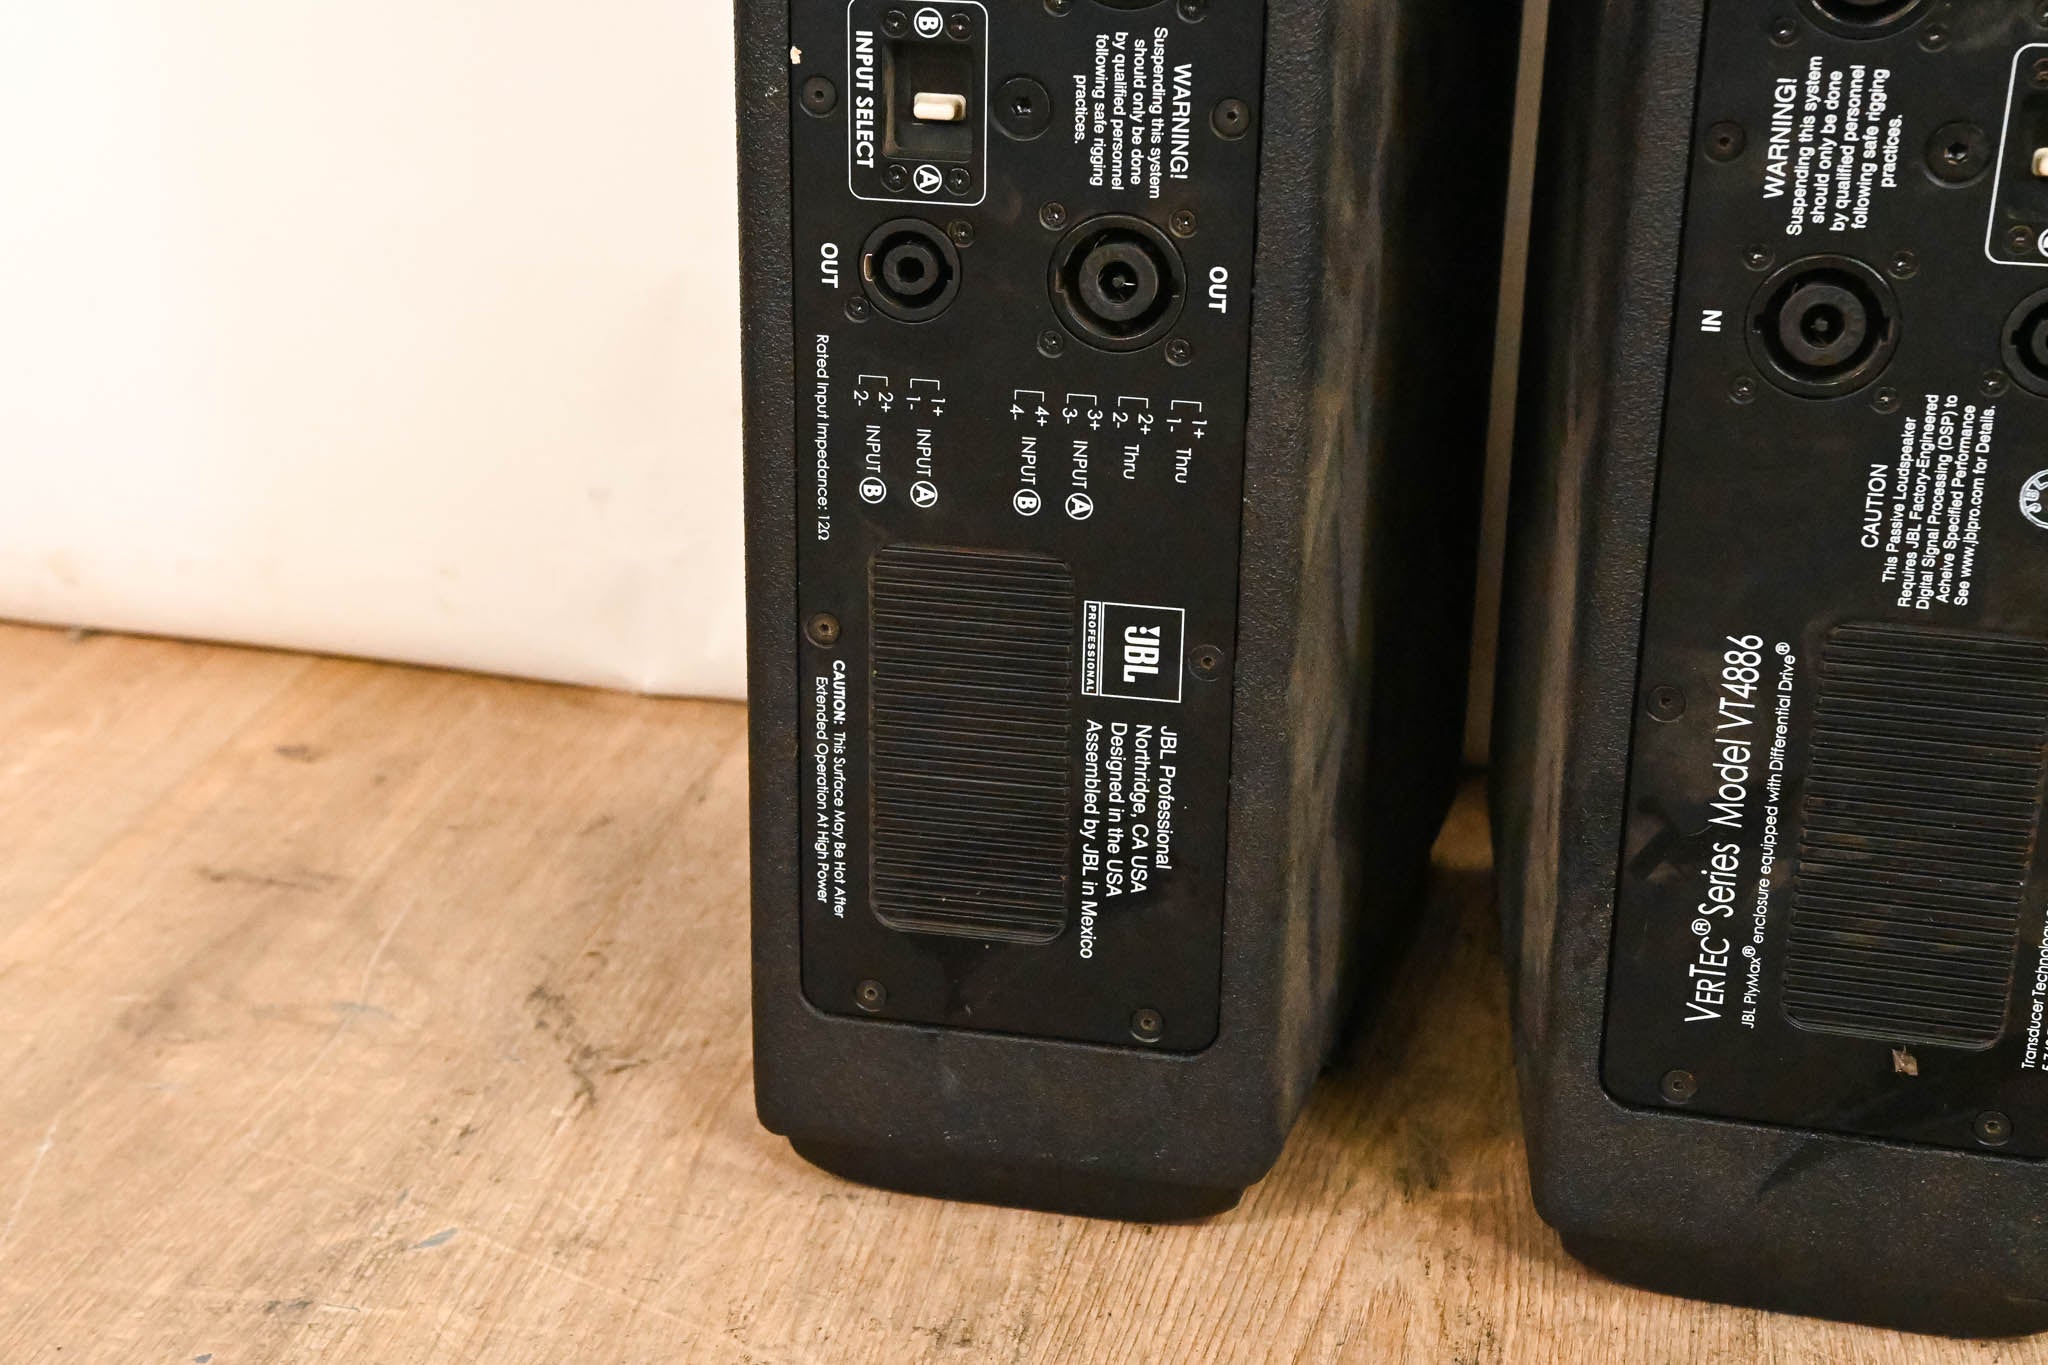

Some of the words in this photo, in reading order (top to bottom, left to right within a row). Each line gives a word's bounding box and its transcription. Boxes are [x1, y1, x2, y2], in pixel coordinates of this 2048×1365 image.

[856, 31, 873, 91] INPUT
[1112, 32, 1128, 50] by
[1133, 39, 1147, 88] should
[1092, 34, 1109, 98] following
[1112, 54, 1127, 115] qualified
[1149, 27, 1168, 114] Suspending
[1805, 56, 1823, 111] system
[1073, 75, 1088, 143] practices.
[1129, 92, 1145, 123] only
[1824, 71, 1843, 110] done
[1844, 65, 1865, 141] personnel
[1865, 69, 1890, 121] rigging
[856, 96, 874, 168] SELECT
[1094, 103, 1107, 133] safe
[1132, 127, 1145, 145] be
[1151, 118, 1164, 143] this
[1170, 64, 1192, 179] WARNING!
[1763, 78, 1797, 198] WARNING!
[1798, 116, 1815, 142] this
[1820, 114, 1837, 134] be
[1862, 126, 1879, 158] safe
[1090, 138, 1106, 186] rigging
[1110, 119, 1124, 190] personnel
[1131, 149, 1144, 184] done
[1147, 148, 1162, 198] system
[1818, 138, 1837, 169] only
[1881, 115, 1902, 187] practices.
[1786, 147, 1815, 235] Suspending
[1810, 174, 1830, 223] should
[1835, 145, 1855, 209] qualified
[1851, 163, 1878, 229] following
[1829, 213, 1849, 231] by
[821, 243, 838, 288] OUT
[1209, 267, 1228, 313] OUT
[1701, 310, 1722, 332] IN
[817, 335, 829, 378] Rated
[814, 383, 829, 419] Input
[1944, 395, 1958, 407] to
[866, 425, 880, 473] INPUT
[916, 429, 931, 477] INPUT
[1937, 411, 1958, 450] (DSP)
[1951, 405, 1976, 487] Performance
[1975, 406, 1995, 453] Details.
[814, 423, 830, 510] Impedance:
[1021, 437, 1036, 485] INPUT
[1072, 441, 1088, 489] INPUT
[1123, 444, 1139, 479] Thru
[1175, 448, 1191, 483] Thru
[1893, 417, 1916, 499] Loudspeaker
[1909, 395, 1939, 520] Factory-Engineered
[1972, 457, 1987, 474] for
[1861, 464, 1888, 548] CAUTION
[1927, 455, 1953, 524] Processing
[1886, 504, 1905, 552] Passive
[1906, 524, 1921, 548] JBL
[1943, 491, 1963, 549] Specified
[1961, 478, 1985, 577] www.jblpro.com
[1882, 557, 1898, 582] This
[1921, 528, 1940, 567] Signal
[1897, 552, 1917, 607] Requires
[1916, 571, 1934, 609] Digital
[1954, 581, 1970, 606] See
[1086, 605, 1096, 691] PROFESSIONAL
[1123, 625, 1161, 683] JBL
[833, 660, 846, 724] CAUTION:
[1716, 635, 1763, 731] VT4886
[816, 677, 829, 740] Extended
[1769, 695, 1791, 770] Differential
[834, 732, 846, 754] This
[1084, 719, 1103, 814] Assembled
[1106, 723, 1127, 803] Designed
[1160, 726, 1177, 759] JBL
[814, 743, 829, 809] Operation
[834, 757, 846, 806] Surface
[1129, 725, 1152, 817] Northridge,
[1708, 739, 1751, 827] Model
[1767, 774, 1782, 802] with
[817, 813, 829, 828] At
[832, 810, 846, 839] May
[1080, 819, 1100, 839] by
[1109, 808, 1124, 822] in
[1132, 824, 1149, 849] CA
[1156, 766, 1176, 869] Professional
[815, 831, 829, 859] High
[834, 842, 846, 858] Be
[1083, 844, 1099, 876] JBL
[1107, 828, 1124, 853] the
[1760, 806, 1778, 874] equipped
[817, 863, 829, 903] Power
[834, 862, 846, 884] Hot
[1082, 882, 1098, 895] in
[1106, 860, 1123, 896] USA
[1131, 856, 1147, 893] USA
[1698, 843, 1740, 917] Series
[834, 887, 846, 918] After
[1753, 878, 1770, 943] enclosure
[1080, 901, 1097, 958] Mexico
[1741, 1008, 1755, 1028] JBL
[2021, 998, 2045, 1069] Transducer
